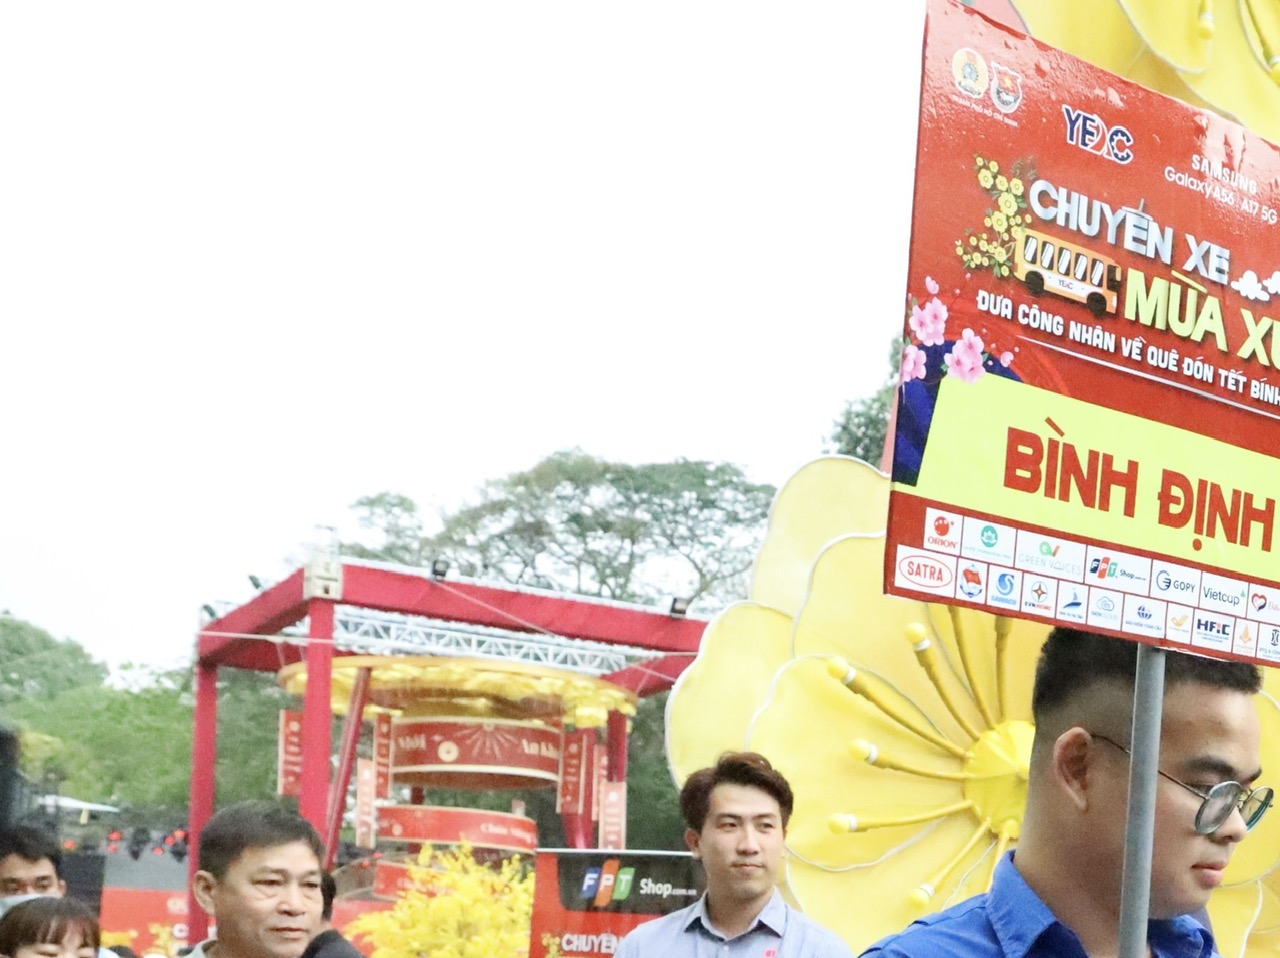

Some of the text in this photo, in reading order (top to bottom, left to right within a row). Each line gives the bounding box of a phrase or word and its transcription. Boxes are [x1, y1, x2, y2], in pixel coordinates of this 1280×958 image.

[1191, 154, 1257, 195] SAMSUNG
[1164, 166, 1279, 225] Galaxy A56 A17 5G
[1029, 179, 1231, 285] CHUYẾN XE
[1124, 268, 1229, 352] MÙA
[976, 289, 1013, 321] ĐƯA
[1018, 304, 1064, 336] CÔNG
[1069, 320, 1116, 353] NHÂN
[1121, 335, 1147, 361] VỀ
[1147, 346, 1179, 372] QUÊ
[1182, 355, 1214, 384] ĐÓN
[1218, 368, 1248, 393] TẾT
[1003, 416, 1139, 518] BÌNH
[1157, 468, 1276, 551] ĐỊNH
[927, 536, 957, 549] ORION
[907, 560, 944, 583] SATRA
[1018, 553, 1046, 568] GREEN
[1090, 559, 1117, 578] FPT
[1173, 580, 1196, 593] GOPY
[1203, 586, 1240, 606] Vietcup
[582, 868, 633, 896] FPT
